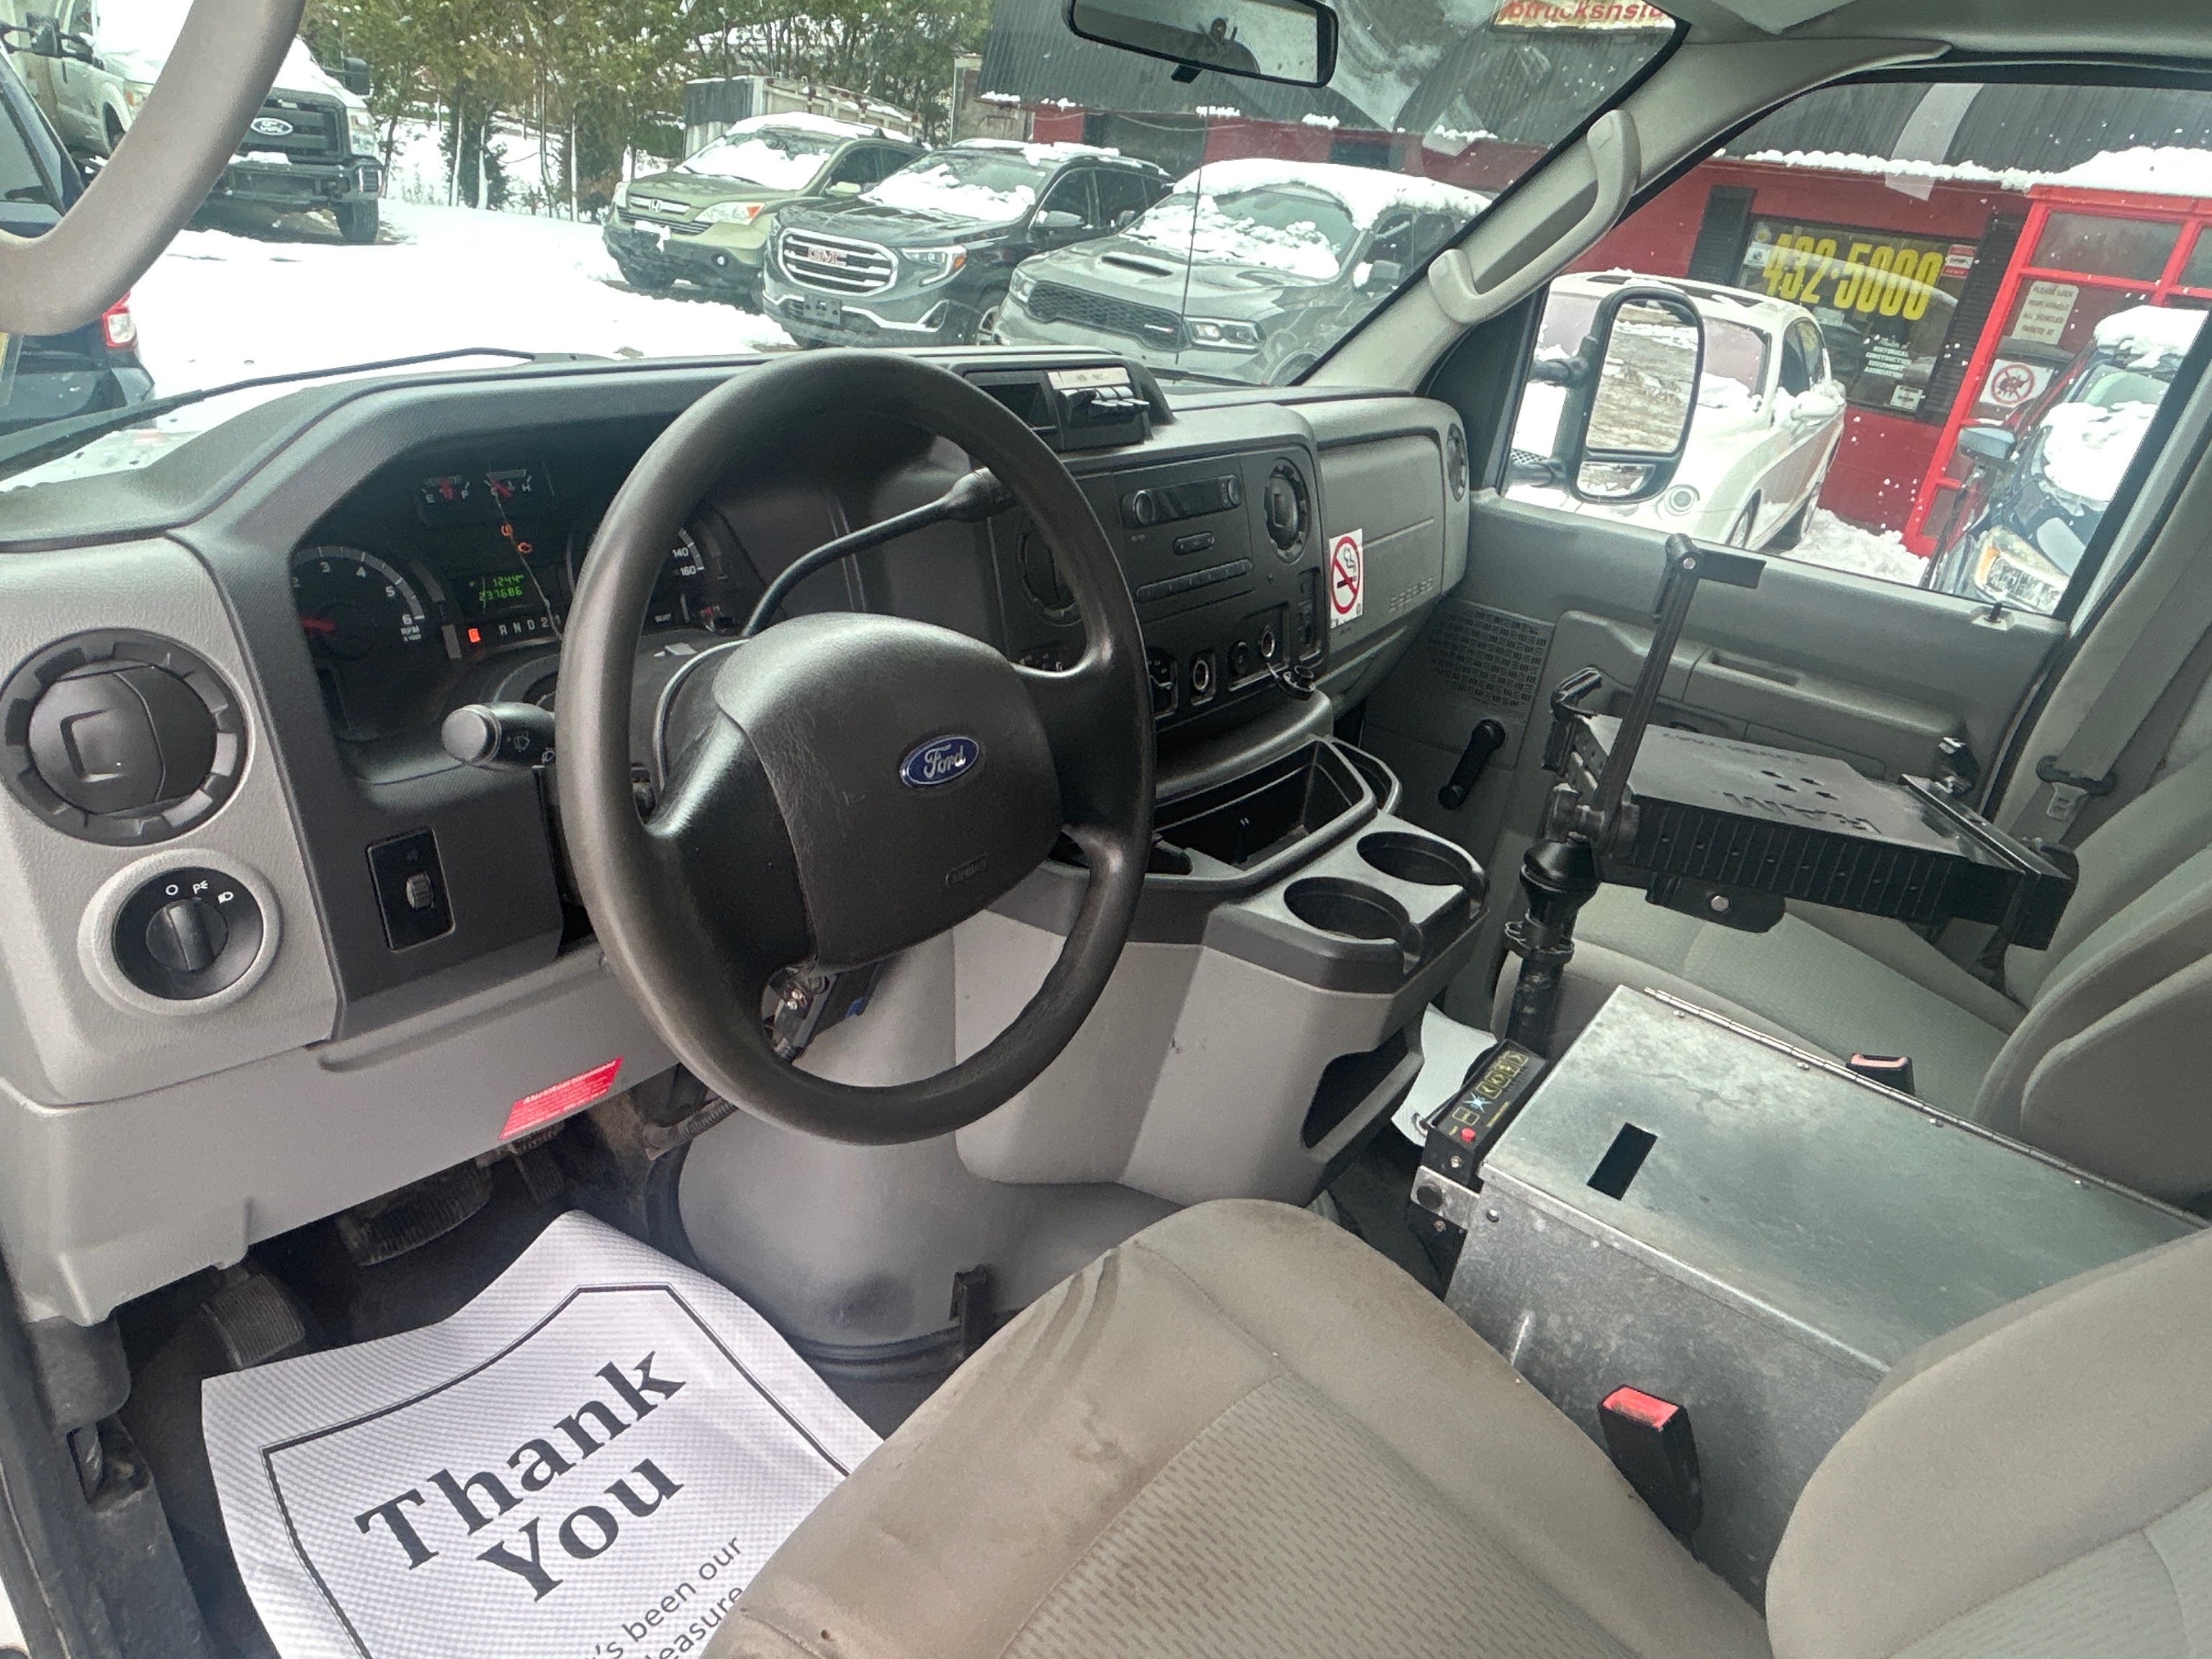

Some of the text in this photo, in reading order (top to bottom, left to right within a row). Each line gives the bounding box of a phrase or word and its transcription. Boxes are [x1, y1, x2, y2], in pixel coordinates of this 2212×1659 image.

[807, 247, 848, 267] GMC
[672, 547, 689, 558] 140
[319, 561, 330, 573] 3
[356, 566, 366, 577] 4
[385, 585, 395, 597] 5
[402, 613, 413, 625] 6
[498, 624, 508, 637] R
[512, 621, 523, 634] N
[526, 619, 536, 631] D
[541, 617, 549, 628] 2
[400, 625, 421, 636] RPM
[923, 742, 966, 778] Ford
[354, 1351, 686, 1571] Thank
[476, 1458, 685, 1603] You
[621, 1582, 697, 1642] been
[698, 1537, 741, 1581] our
[644, 1587, 743, 1659] easure
